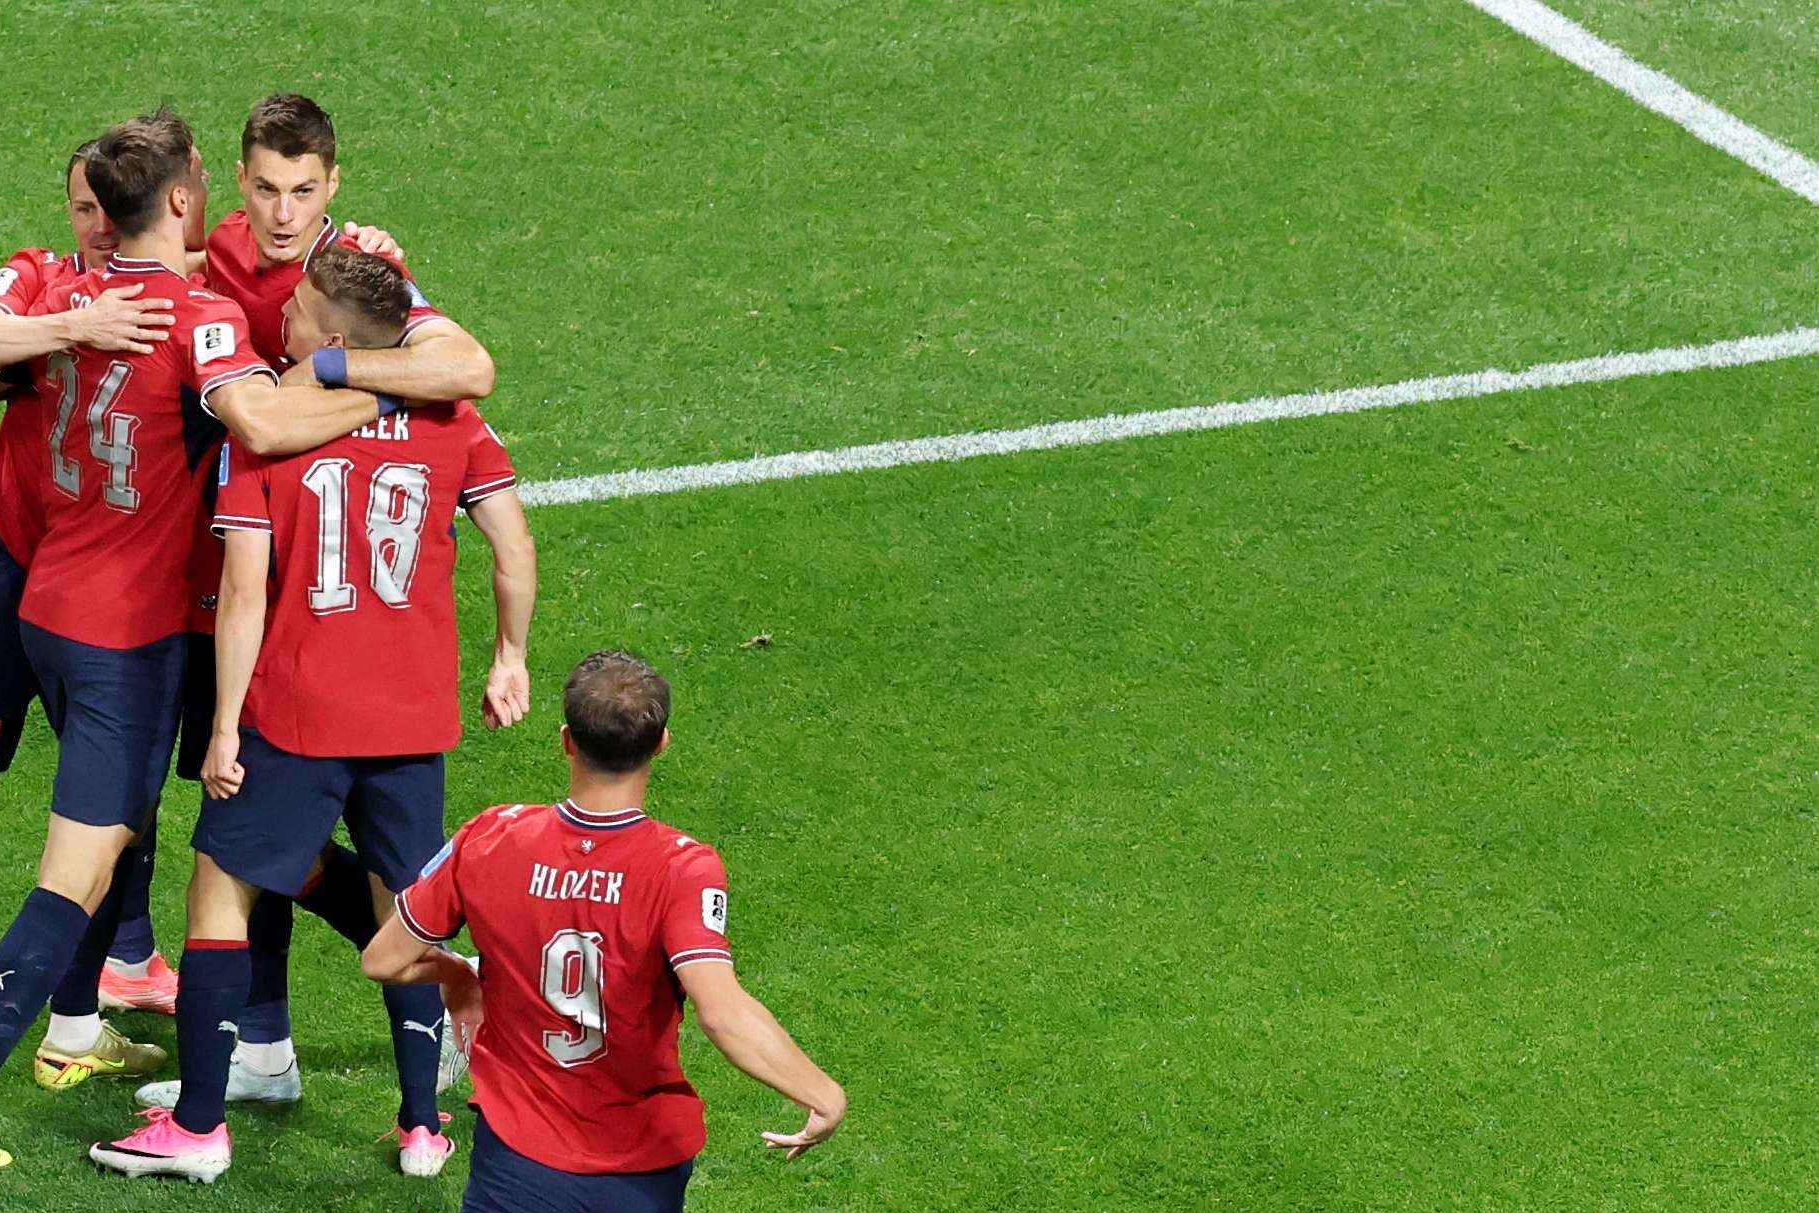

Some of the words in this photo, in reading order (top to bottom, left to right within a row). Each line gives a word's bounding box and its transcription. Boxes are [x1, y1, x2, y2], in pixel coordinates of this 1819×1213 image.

[46, 350, 141, 514] 24
[302, 458, 431, 615] 18
[540, 928, 608, 1068] 9
